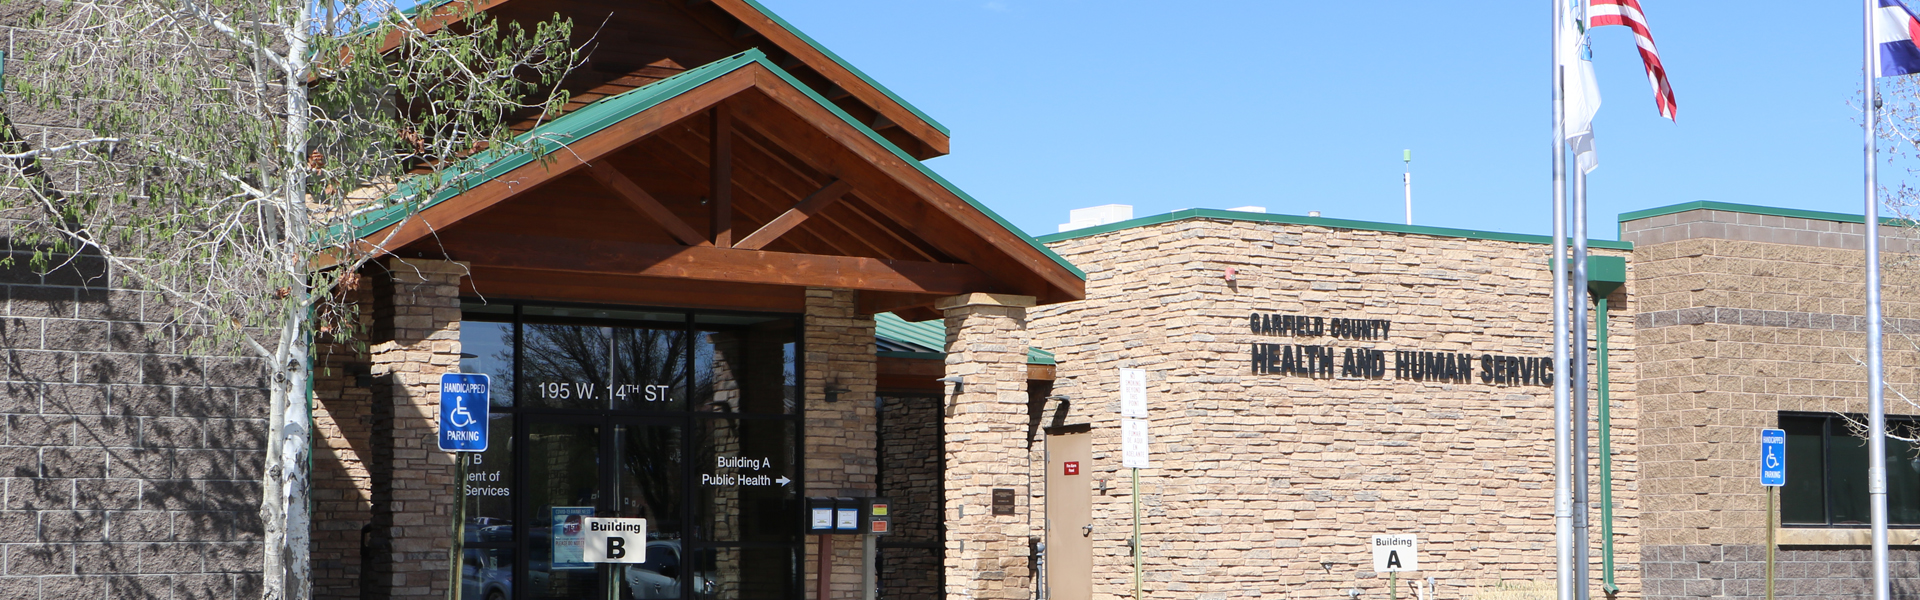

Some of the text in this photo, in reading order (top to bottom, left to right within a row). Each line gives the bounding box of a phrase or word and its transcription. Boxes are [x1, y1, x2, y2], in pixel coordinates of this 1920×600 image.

[1250, 313, 1391, 340] GARFIELD COUNTY
[1251, 343, 1573, 387] HEALTH AND HUMAN SERVIC
[444, 383, 485, 394] HANDICAPPED
[538, 382, 673, 401] 195 W. 14TH ST.
[447, 430, 479, 441] PARKING
[473, 453, 483, 465] B
[717, 456, 771, 471] Building A
[488, 470, 500, 482] of
[702, 473, 771, 486] Public Health
[465, 485, 510, 496] Services
[590, 521, 641, 534] Building
[606, 536, 626, 559] B
[1375, 537, 1412, 547] Building
[1386, 549, 1402, 569] A
